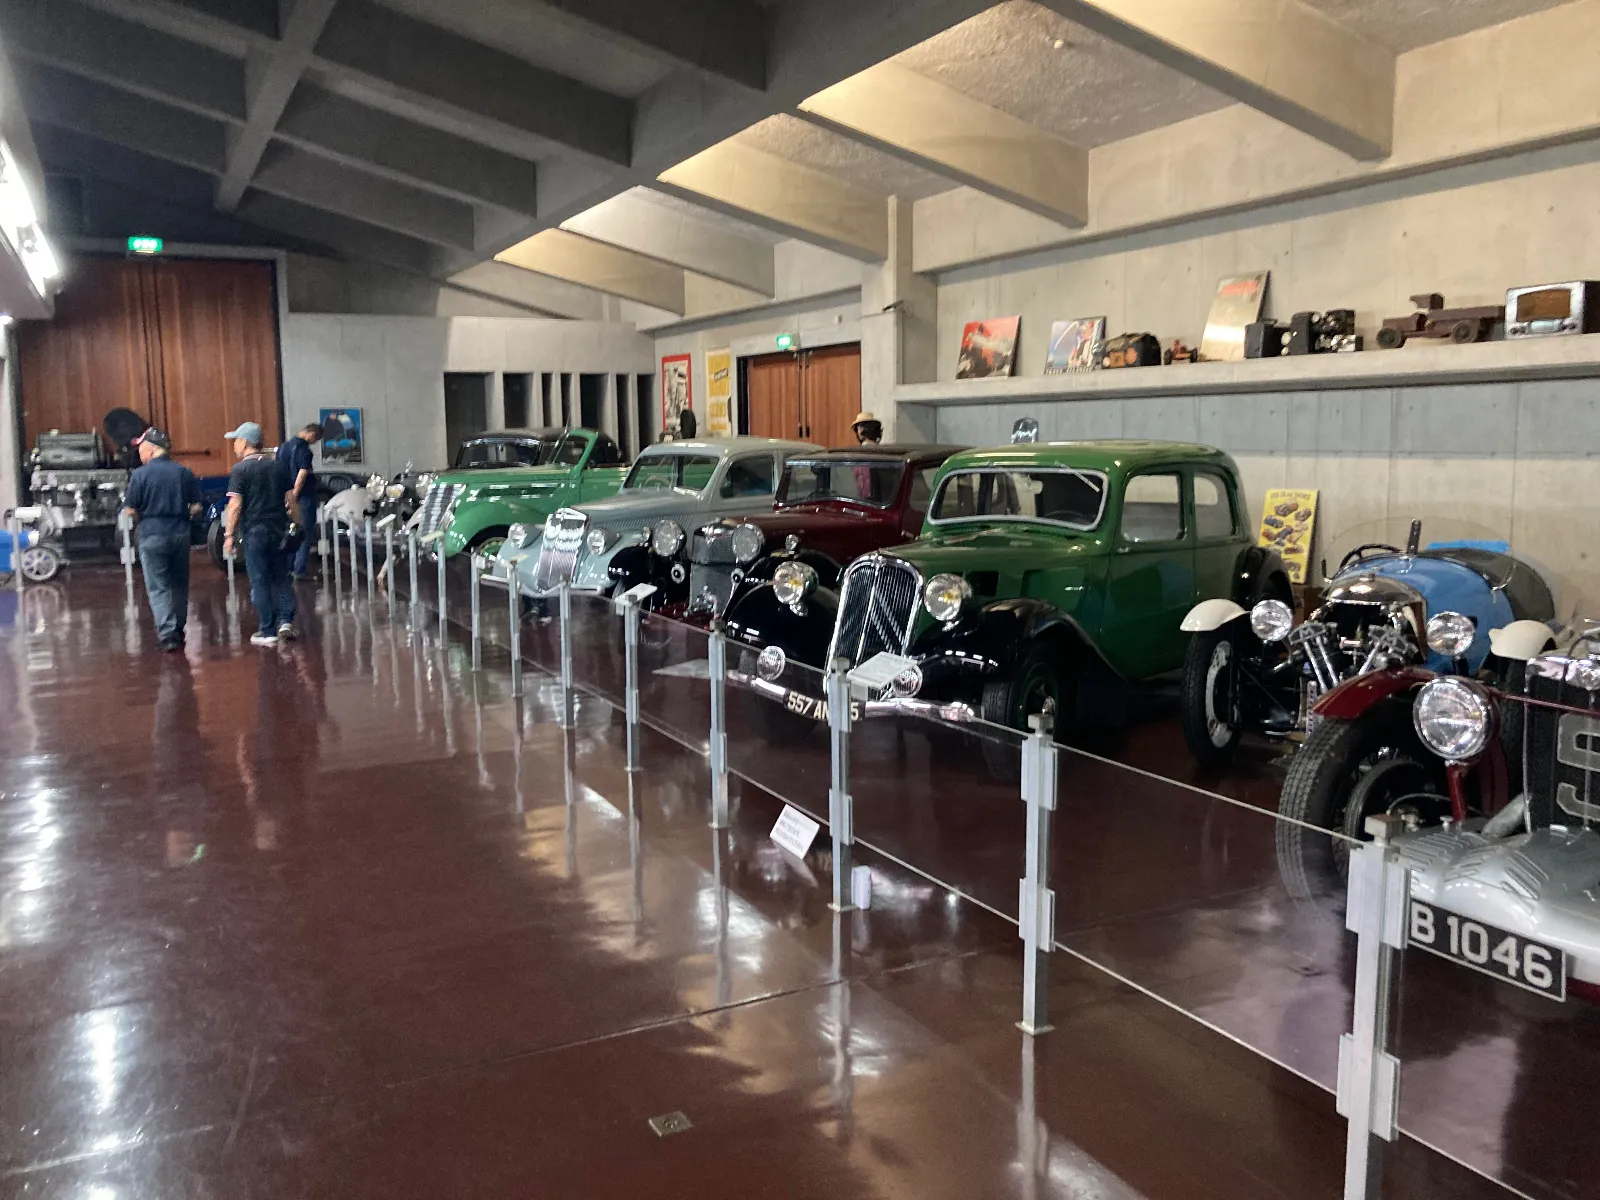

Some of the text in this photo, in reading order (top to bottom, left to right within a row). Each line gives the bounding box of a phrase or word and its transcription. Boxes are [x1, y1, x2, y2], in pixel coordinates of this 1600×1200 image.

[787, 691, 814, 715] 557
[1410, 901, 1553, 989] B 1046
